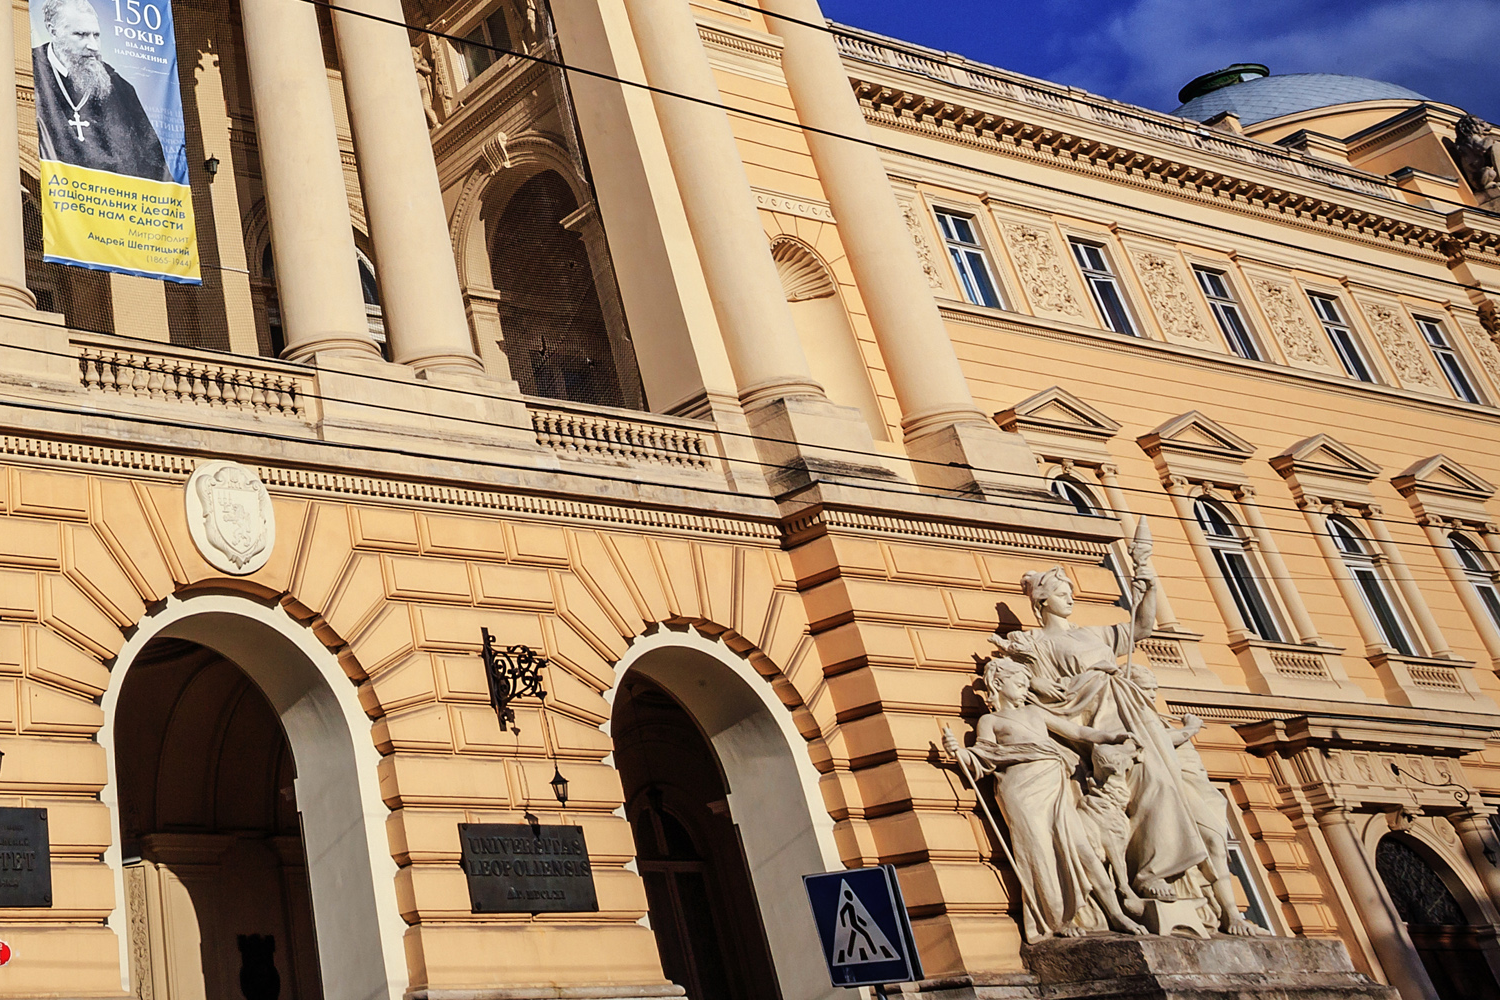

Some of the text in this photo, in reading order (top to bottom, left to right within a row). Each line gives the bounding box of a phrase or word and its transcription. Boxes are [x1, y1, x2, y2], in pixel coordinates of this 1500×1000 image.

[114, 26, 165, 46] РОКІВ
[114, 48, 168, 65] НАРОДЖЕННЯ
[48, 174, 182, 207] До осягнення наших
[49, 188, 186, 219] національних ідеалів
[53, 201, 183, 230] треба нам єдности
[88, 232, 190, 256] Андрей Шептицький
[128, 229, 189, 243] Митрополит
[146, 254, 192, 270] (1865-1944)
[468, 837, 581, 855] UNIVERSITAS
[468, 859, 590, 877] LEOPOLIENSIS
